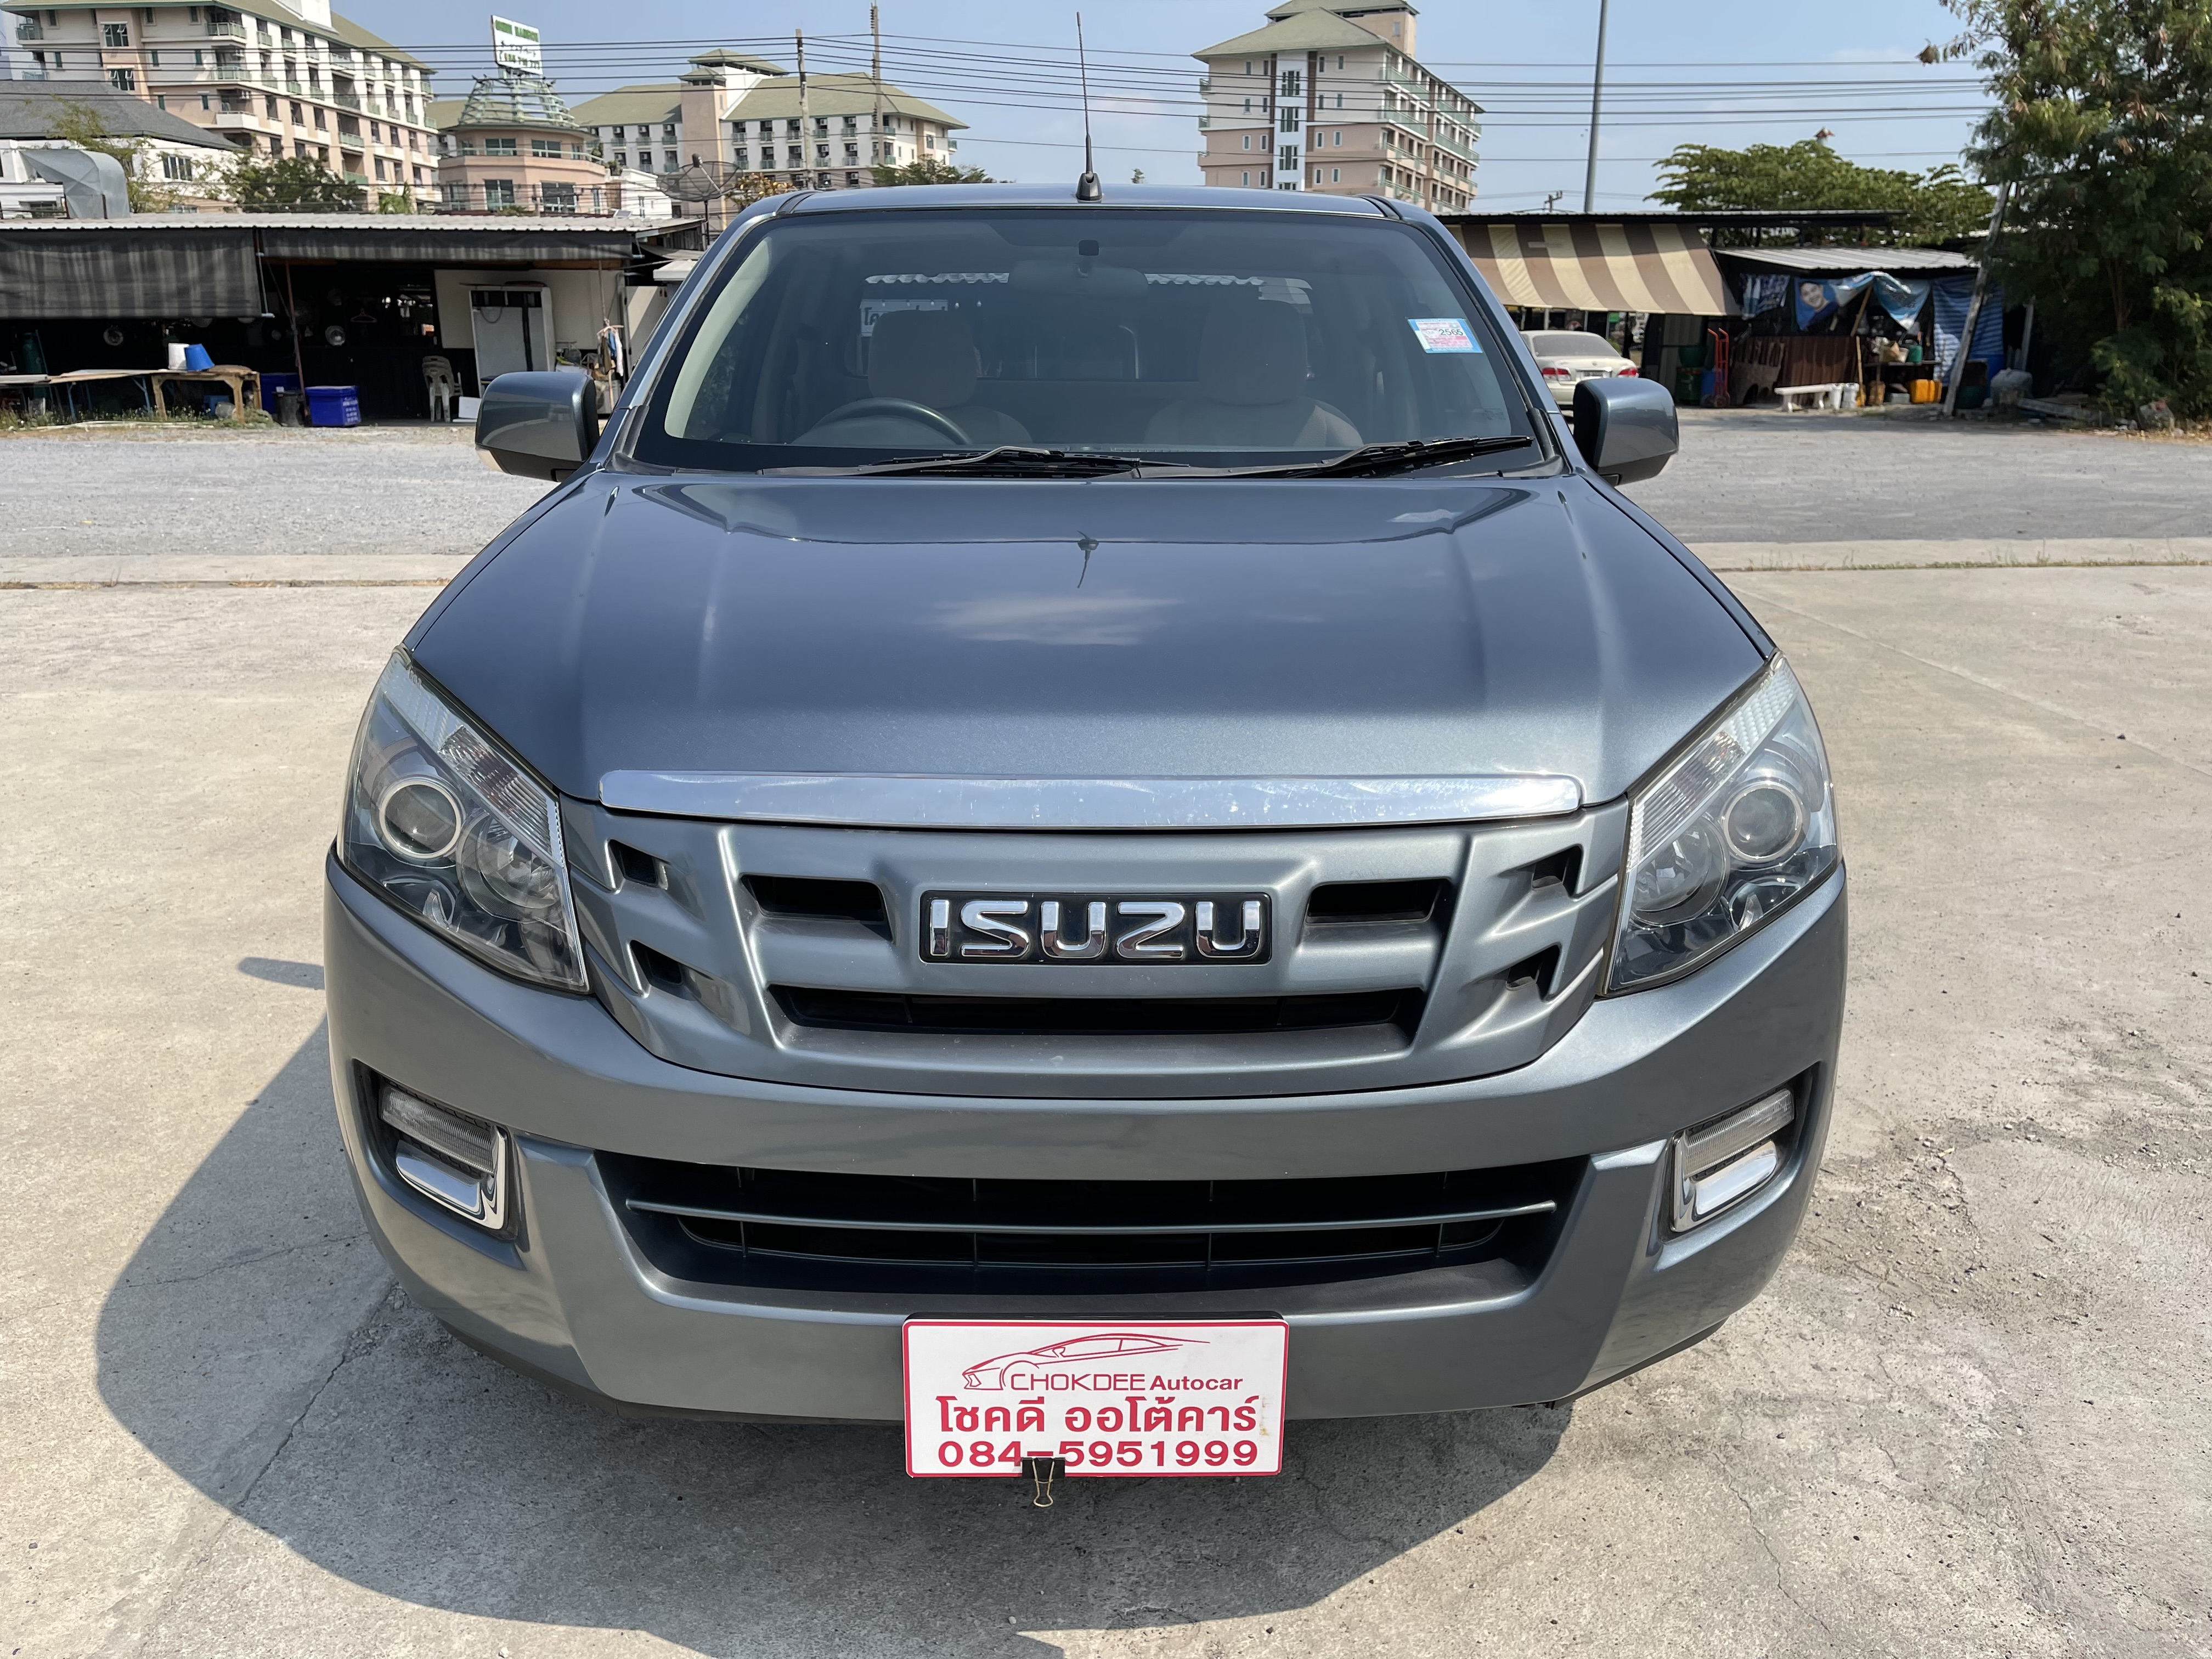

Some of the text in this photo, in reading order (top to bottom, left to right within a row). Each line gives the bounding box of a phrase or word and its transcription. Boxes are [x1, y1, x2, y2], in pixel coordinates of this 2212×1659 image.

[930, 900, 1261, 958] ISUZU
[1010, 1373, 1243, 1391] CHOKDEE Autocar
[935, 1395, 1259, 1432] โชคดี ออโต้คาร์
[937, 1440, 1259, 1468] 084-5951999
